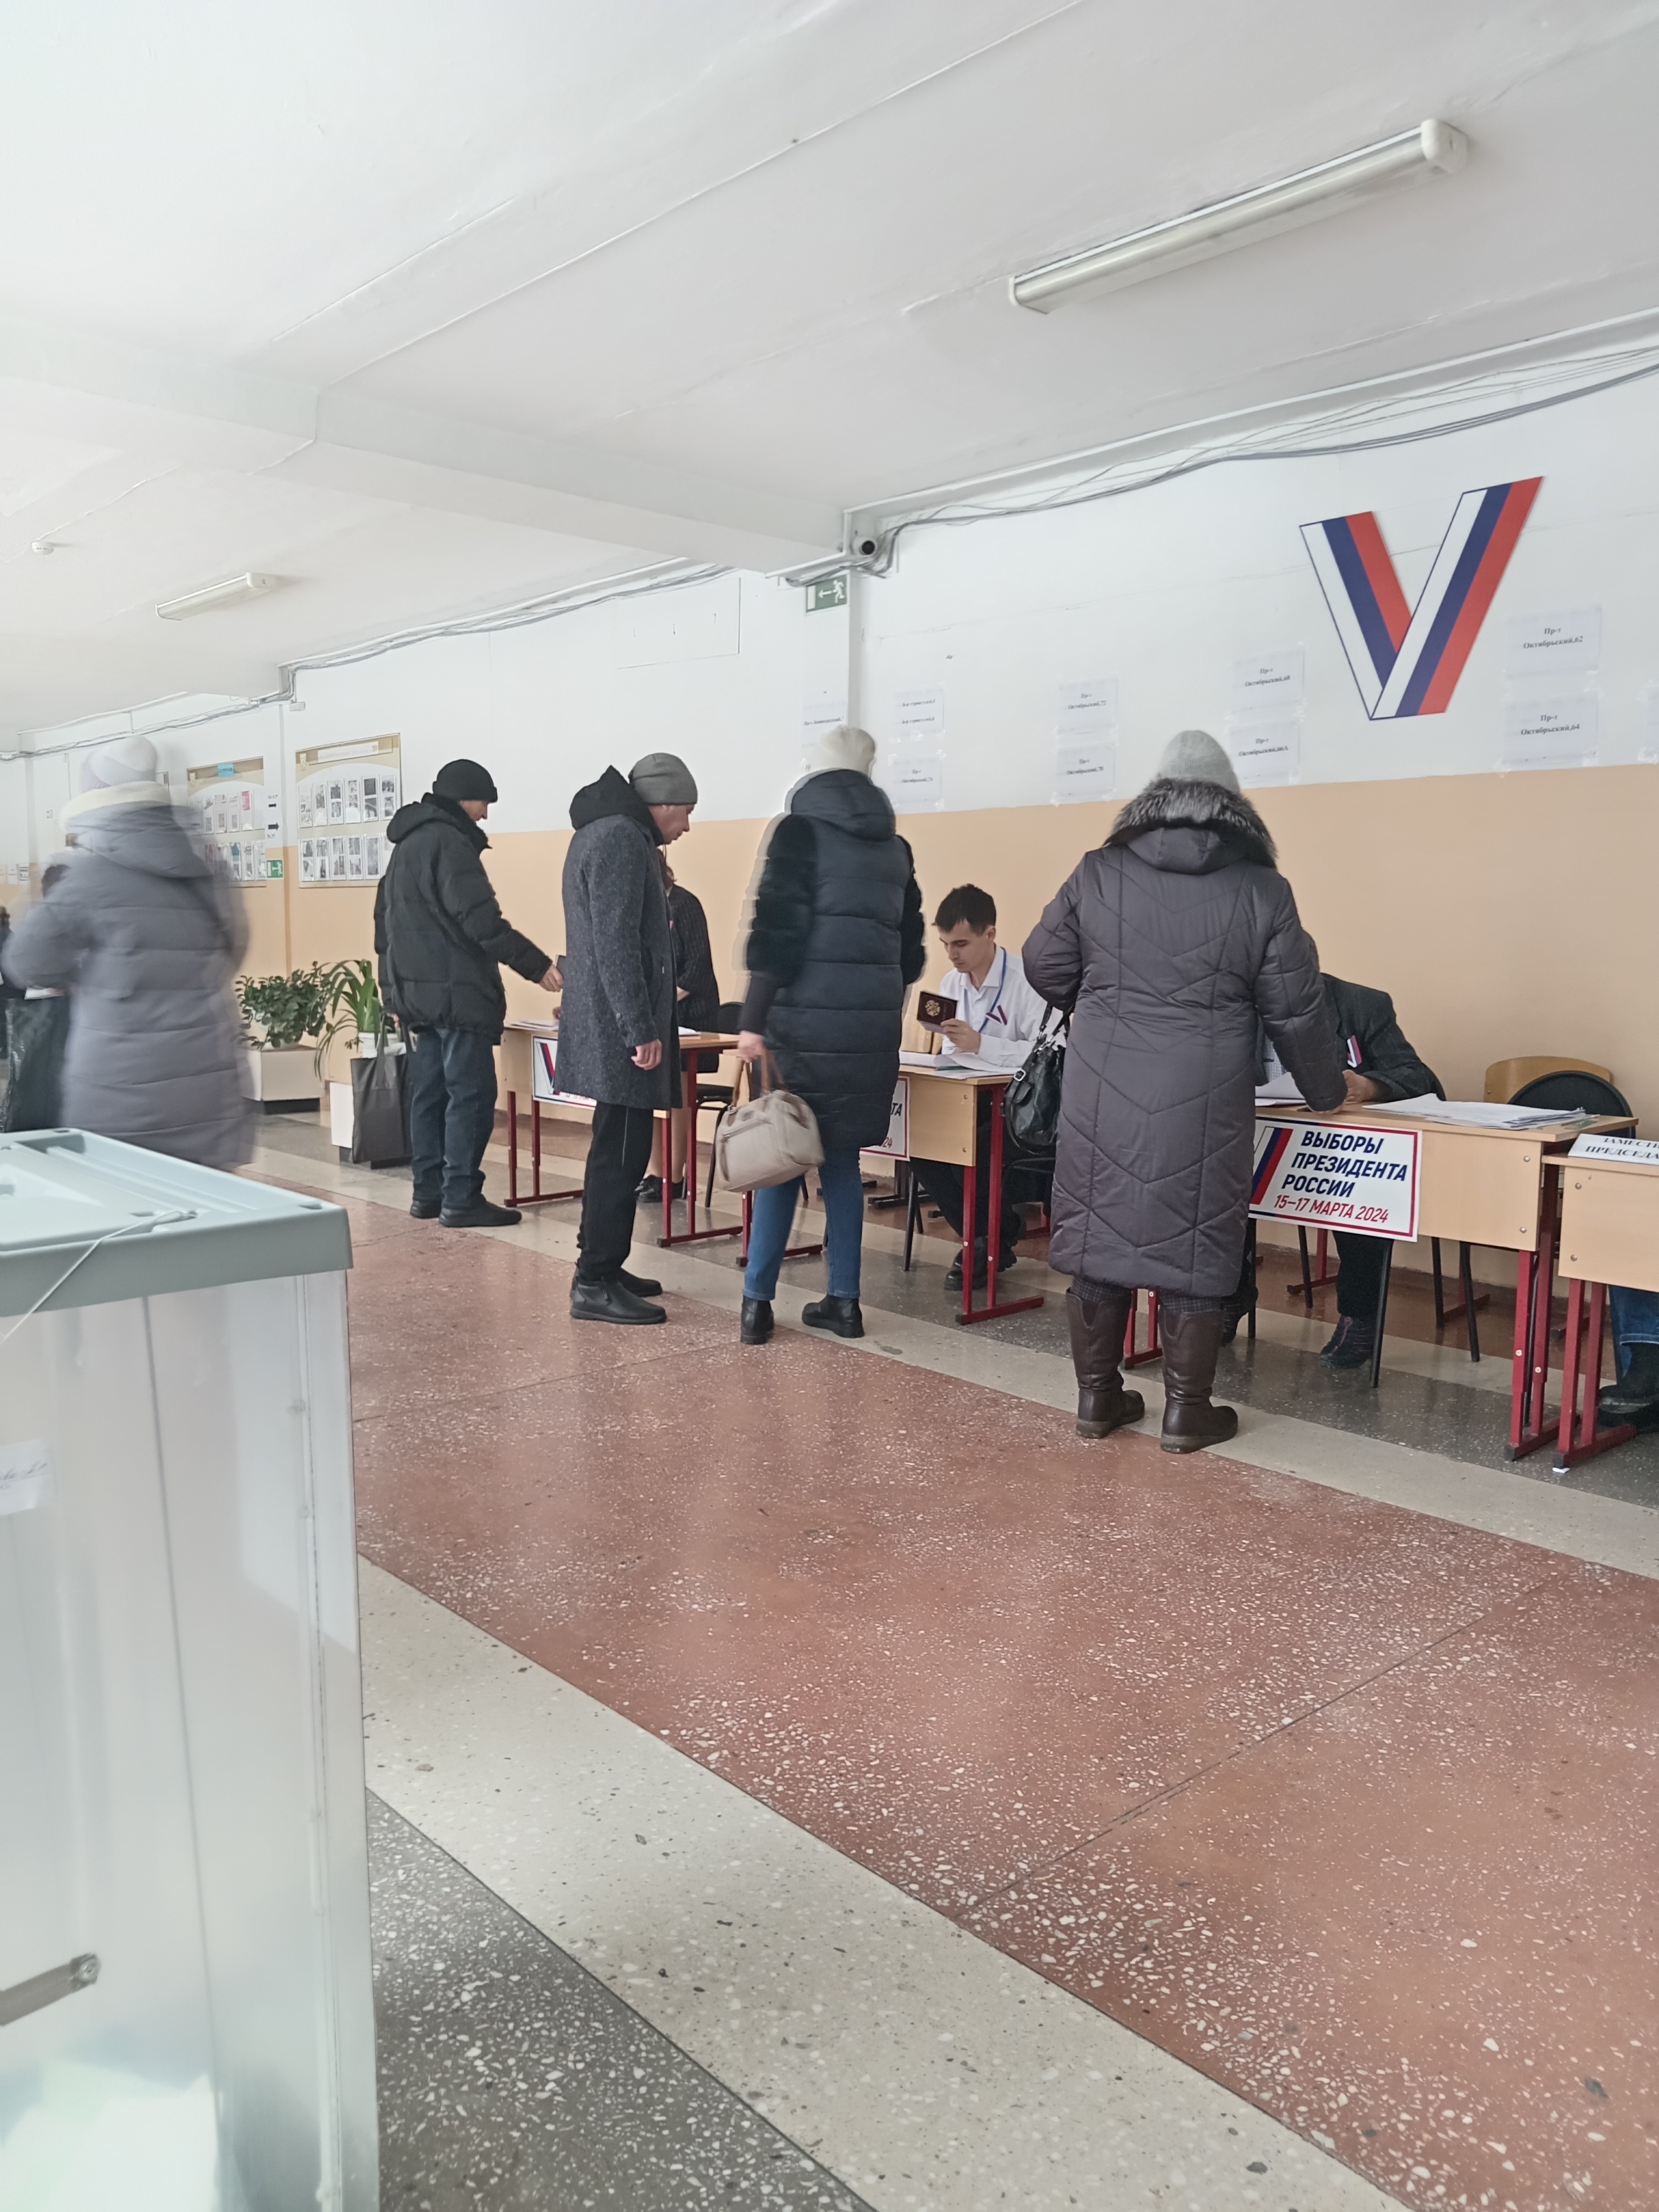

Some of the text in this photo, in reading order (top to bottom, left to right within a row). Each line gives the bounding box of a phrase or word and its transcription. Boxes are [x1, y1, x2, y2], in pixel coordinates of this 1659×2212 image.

[1300, 1131, 1384, 1154] ВЫБОРЫ
[1291, 1152, 1407, 1182] ПРЕЗИДЕНТА
[1281, 1174, 1355, 1198] РОССИИ
[1309, 1199, 1355, 1218] МАРТА
[1354, 1206, 1389, 1223] 2024
